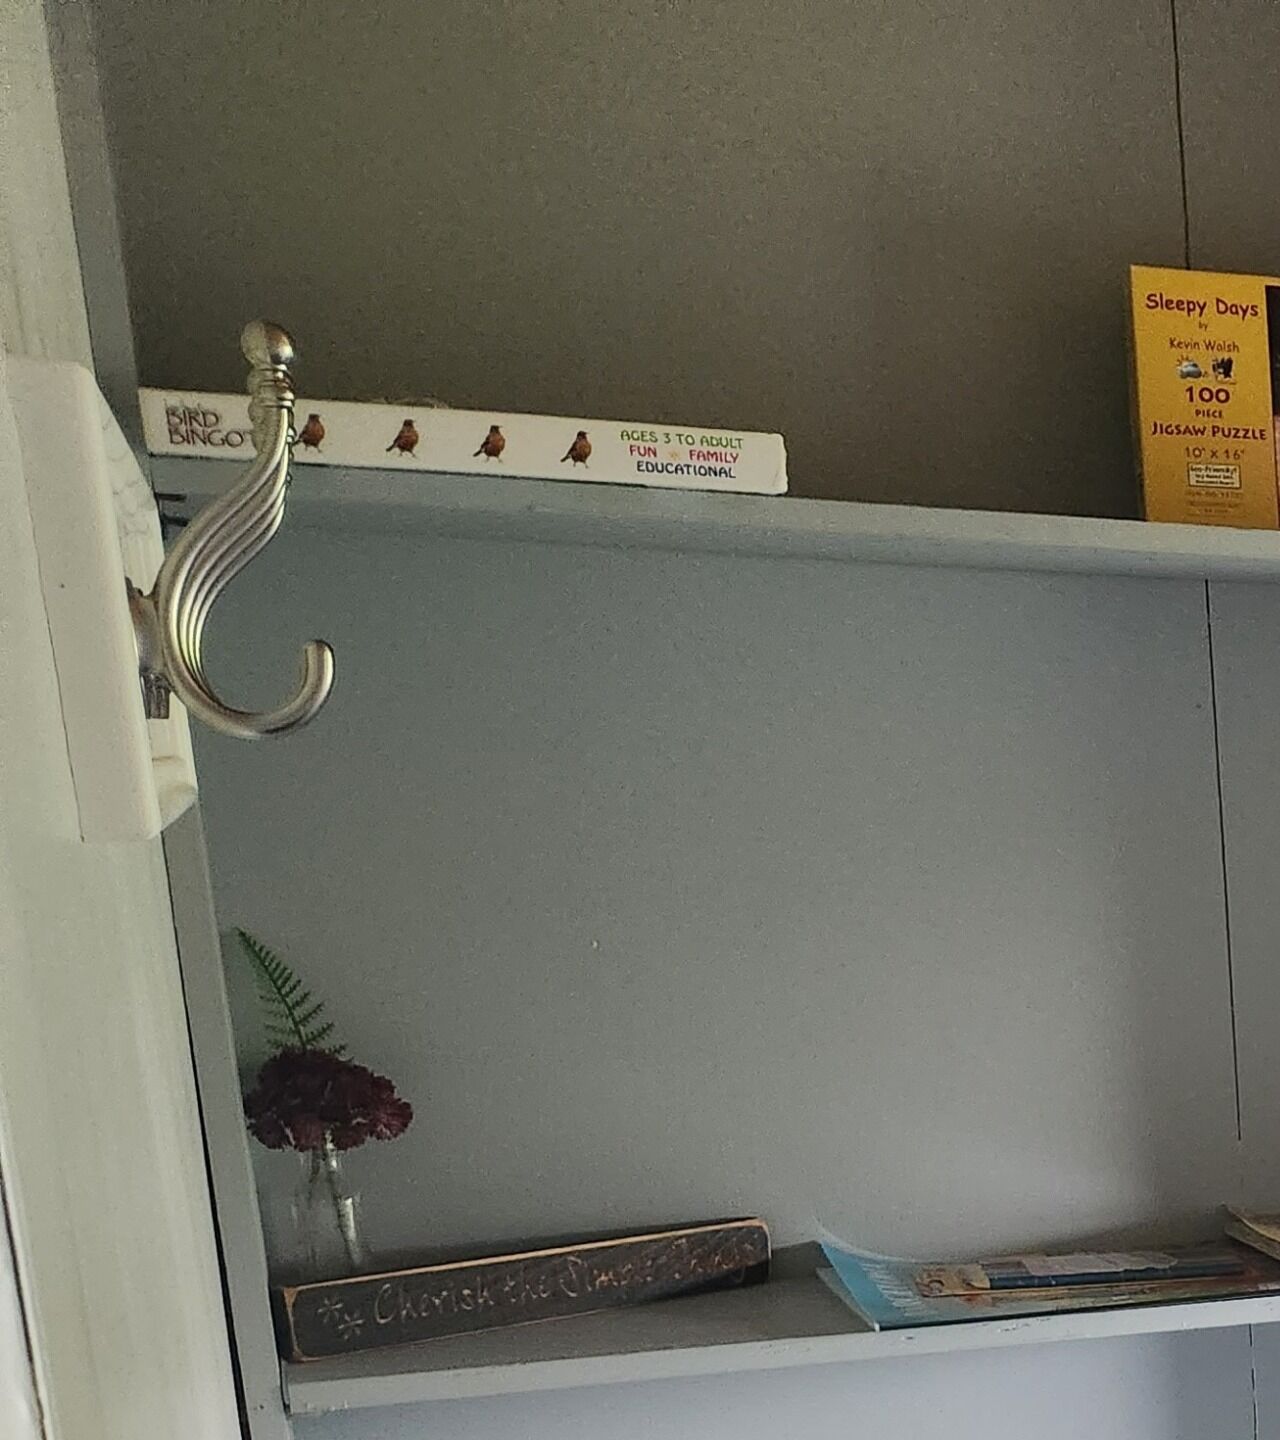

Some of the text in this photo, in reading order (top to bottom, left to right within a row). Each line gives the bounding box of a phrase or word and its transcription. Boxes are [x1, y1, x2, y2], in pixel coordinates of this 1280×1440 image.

[1146, 292, 1259, 321] Sleepy Days
[1169, 337, 1240, 353] Kevin Walsh
[1185, 385, 1231, 404] 100
[165, 404, 219, 429] BIRD
[1195, 408, 1223, 419] PIECE
[168, 425, 244, 449] BINGO
[621, 430, 743, 449] AGES 3 TO ADULT
[1152, 421, 1268, 441] JIGSAW PUZZLE
[629, 445, 739, 464] FUN FAMILY
[637, 461, 736, 479] EDUCATIONAL
[375, 1275, 495, 1324] Cherish
